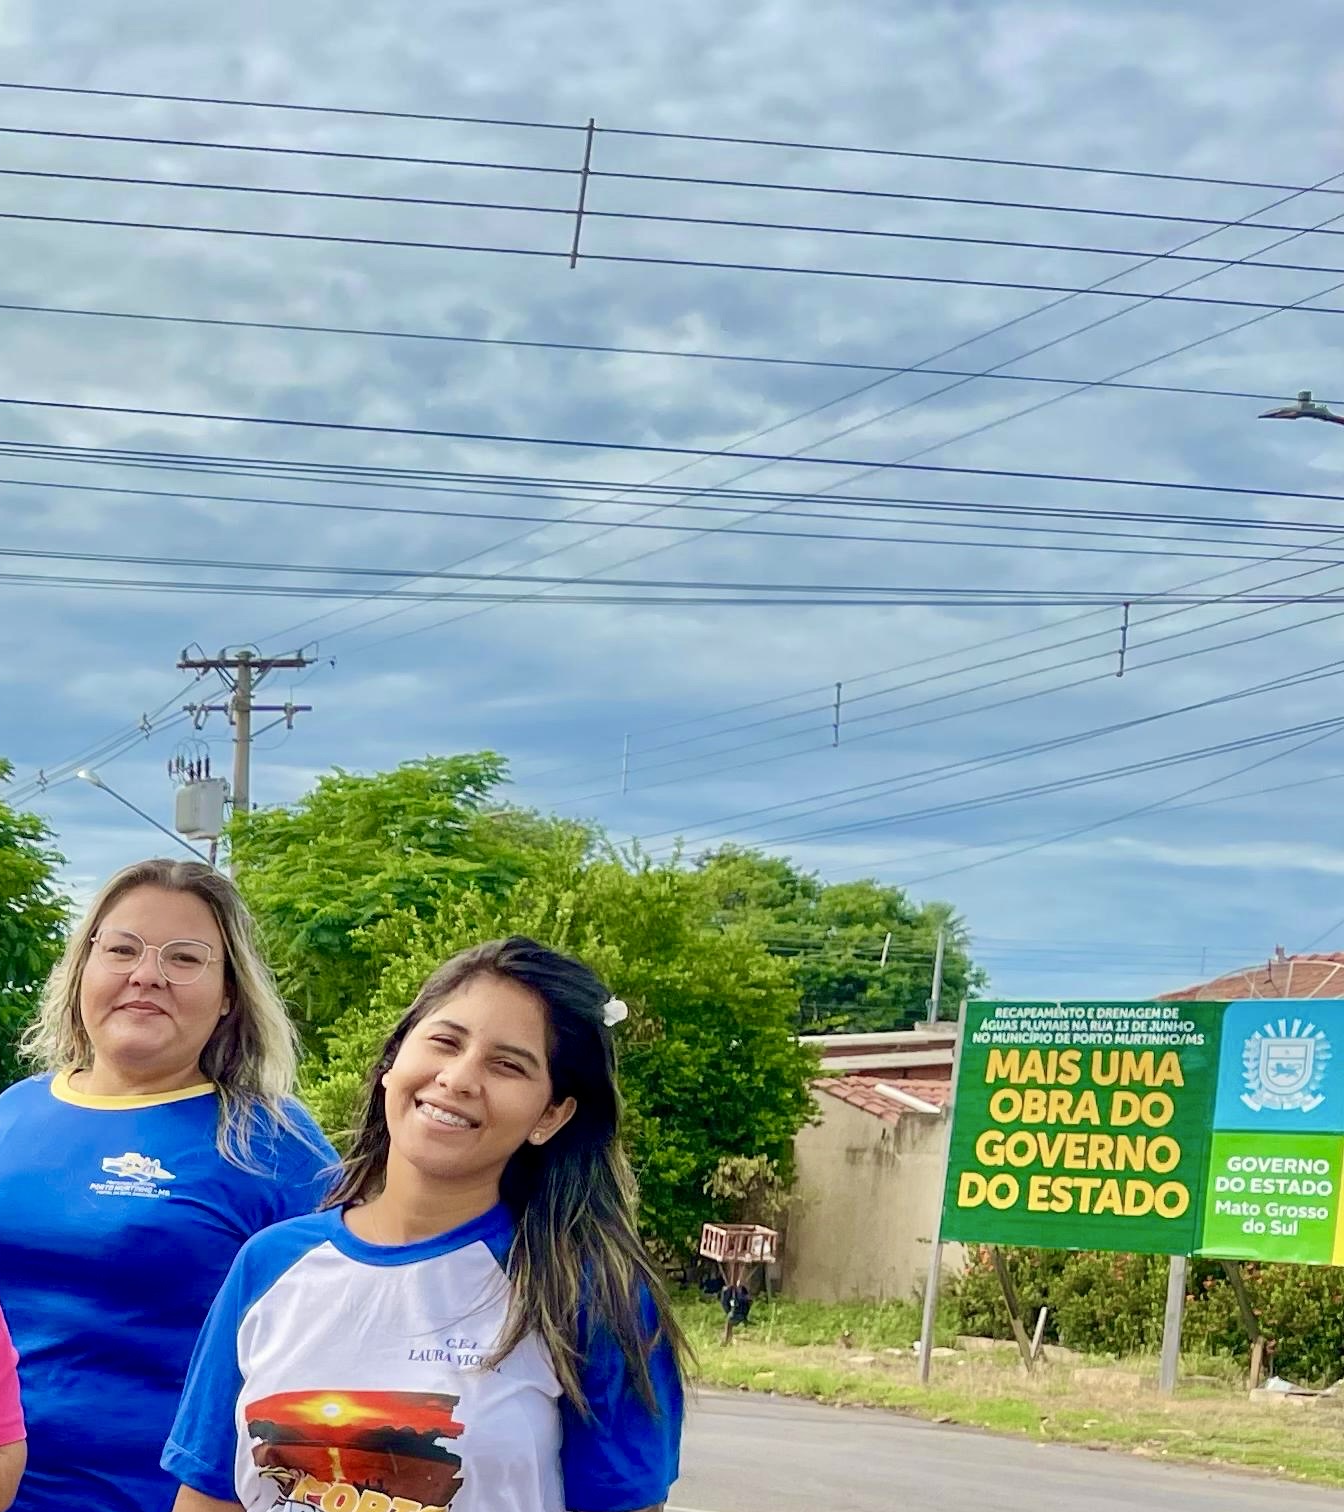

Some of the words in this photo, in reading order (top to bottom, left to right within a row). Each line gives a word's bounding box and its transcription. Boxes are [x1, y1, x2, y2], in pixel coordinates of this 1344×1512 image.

[995, 1007, 1086, 1019] RECAPEAMENTO
[1087, 1008, 1094, 1019] E
[1096, 1008, 1162, 1020] DRENAGEM
[1164, 1008, 1179, 1019] DE
[980, 1018, 1018, 1031] ÁGUAS
[1020, 1019, 1069, 1032] PLUVIAIS
[1071, 1021, 1088, 1032] NA
[1090, 1021, 1113, 1032] RUA
[1115, 1021, 1129, 1032] 13
[1131, 1021, 1148, 1033] DE
[1149, 1021, 1194, 1033] JUNHO
[972, 1032, 991, 1044] NO
[992, 1030, 1052, 1044] MUNICÍPIO
[1054, 1033, 1071, 1044] DE
[1073, 1033, 1112, 1045] PORTO
[1114, 1033, 1205, 1046] MURTINHO/MS
[985, 1049, 1082, 1086] MAIS
[1091, 1050, 1184, 1087] UMA
[989, 1088, 1101, 1125] OBRA
[1110, 1091, 1174, 1128] DO
[975, 1130, 1181, 1173] GOVERNO
[1227, 1156, 1330, 1175] GOVERNO
[957, 1172, 1020, 1209] DO
[1028, 1175, 1190, 1219] ESTADO
[1215, 1176, 1246, 1193] DO
[1250, 1177, 1333, 1196] ESTADO
[1215, 1200, 1261, 1217] Mato
[1265, 1202, 1329, 1220] Grosso
[1242, 1218, 1266, 1234] do
[1270, 1220, 1299, 1236] Sul
[408, 1349, 452, 1363] LAURA
